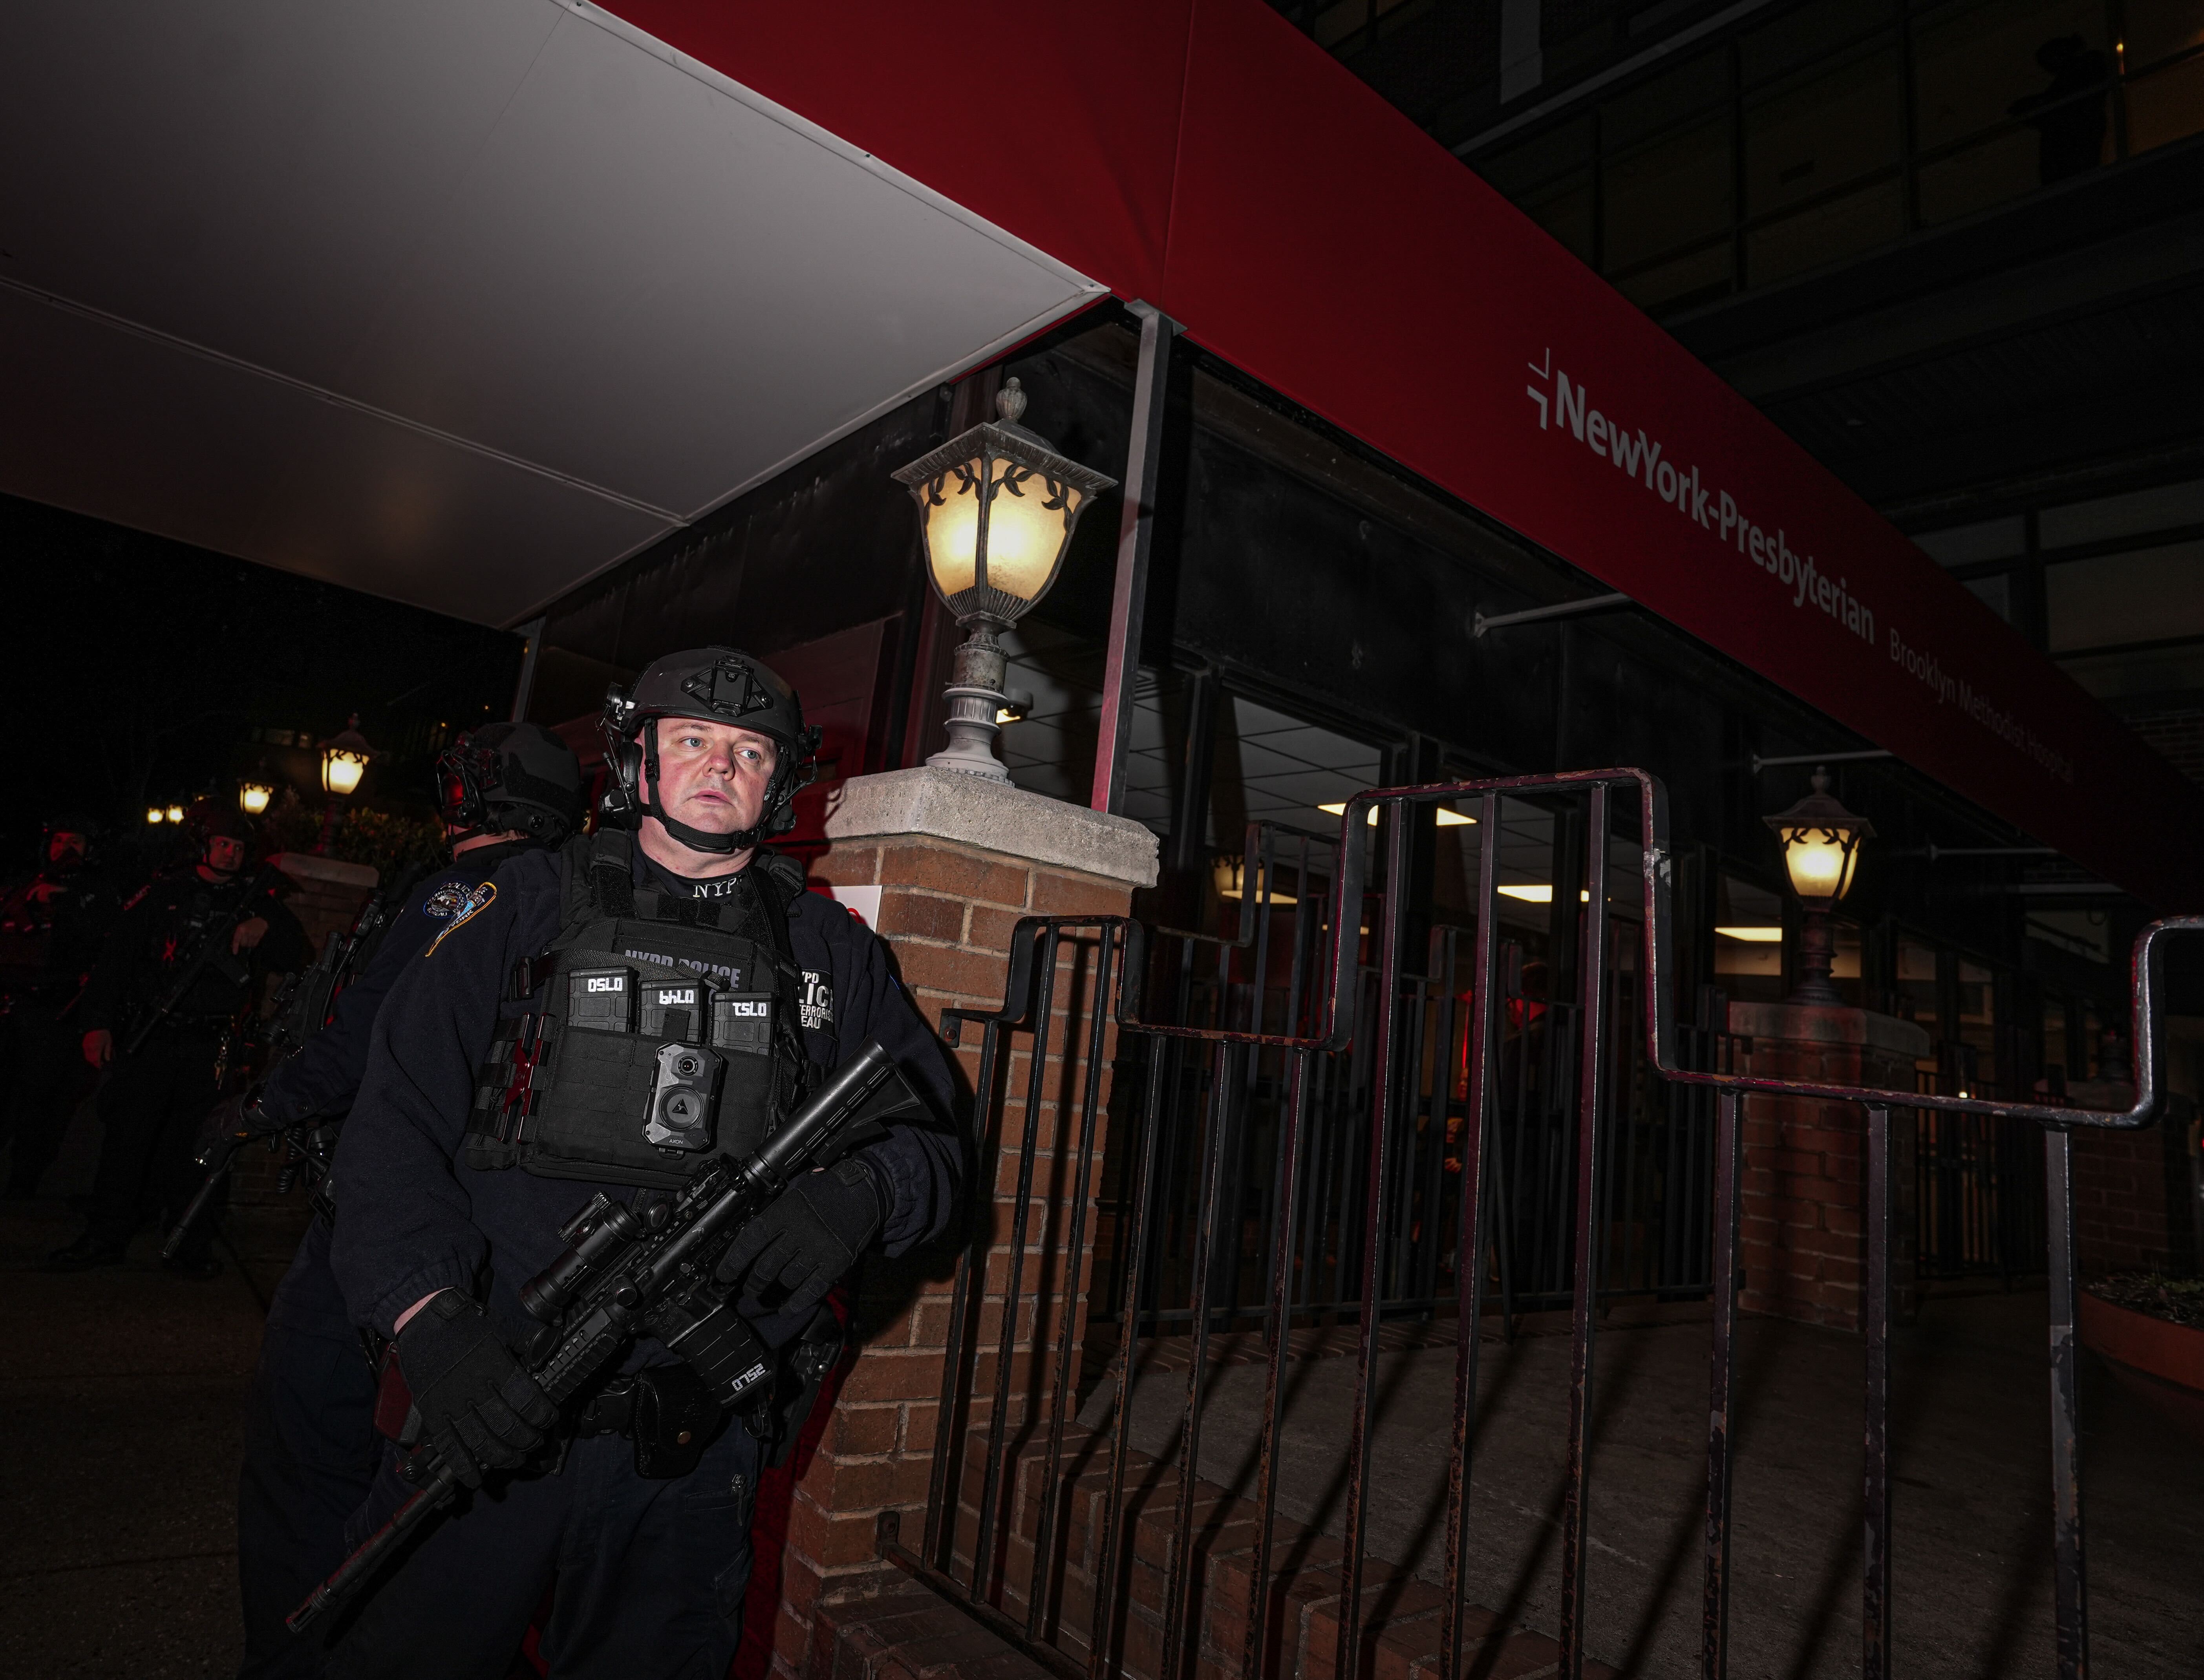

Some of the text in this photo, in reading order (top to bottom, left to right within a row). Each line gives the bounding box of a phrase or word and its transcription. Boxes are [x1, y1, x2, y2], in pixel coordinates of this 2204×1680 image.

[1555, 369, 1875, 645] NewYork-Presbyterian
[1889, 627, 1956, 705] Brooklyn
[1959, 679, 2027, 753] Methodist
[801, 971, 819, 984] PD
[799, 1004, 834, 1023] ERRORIS
[732, 1363, 766, 1391] 0752
